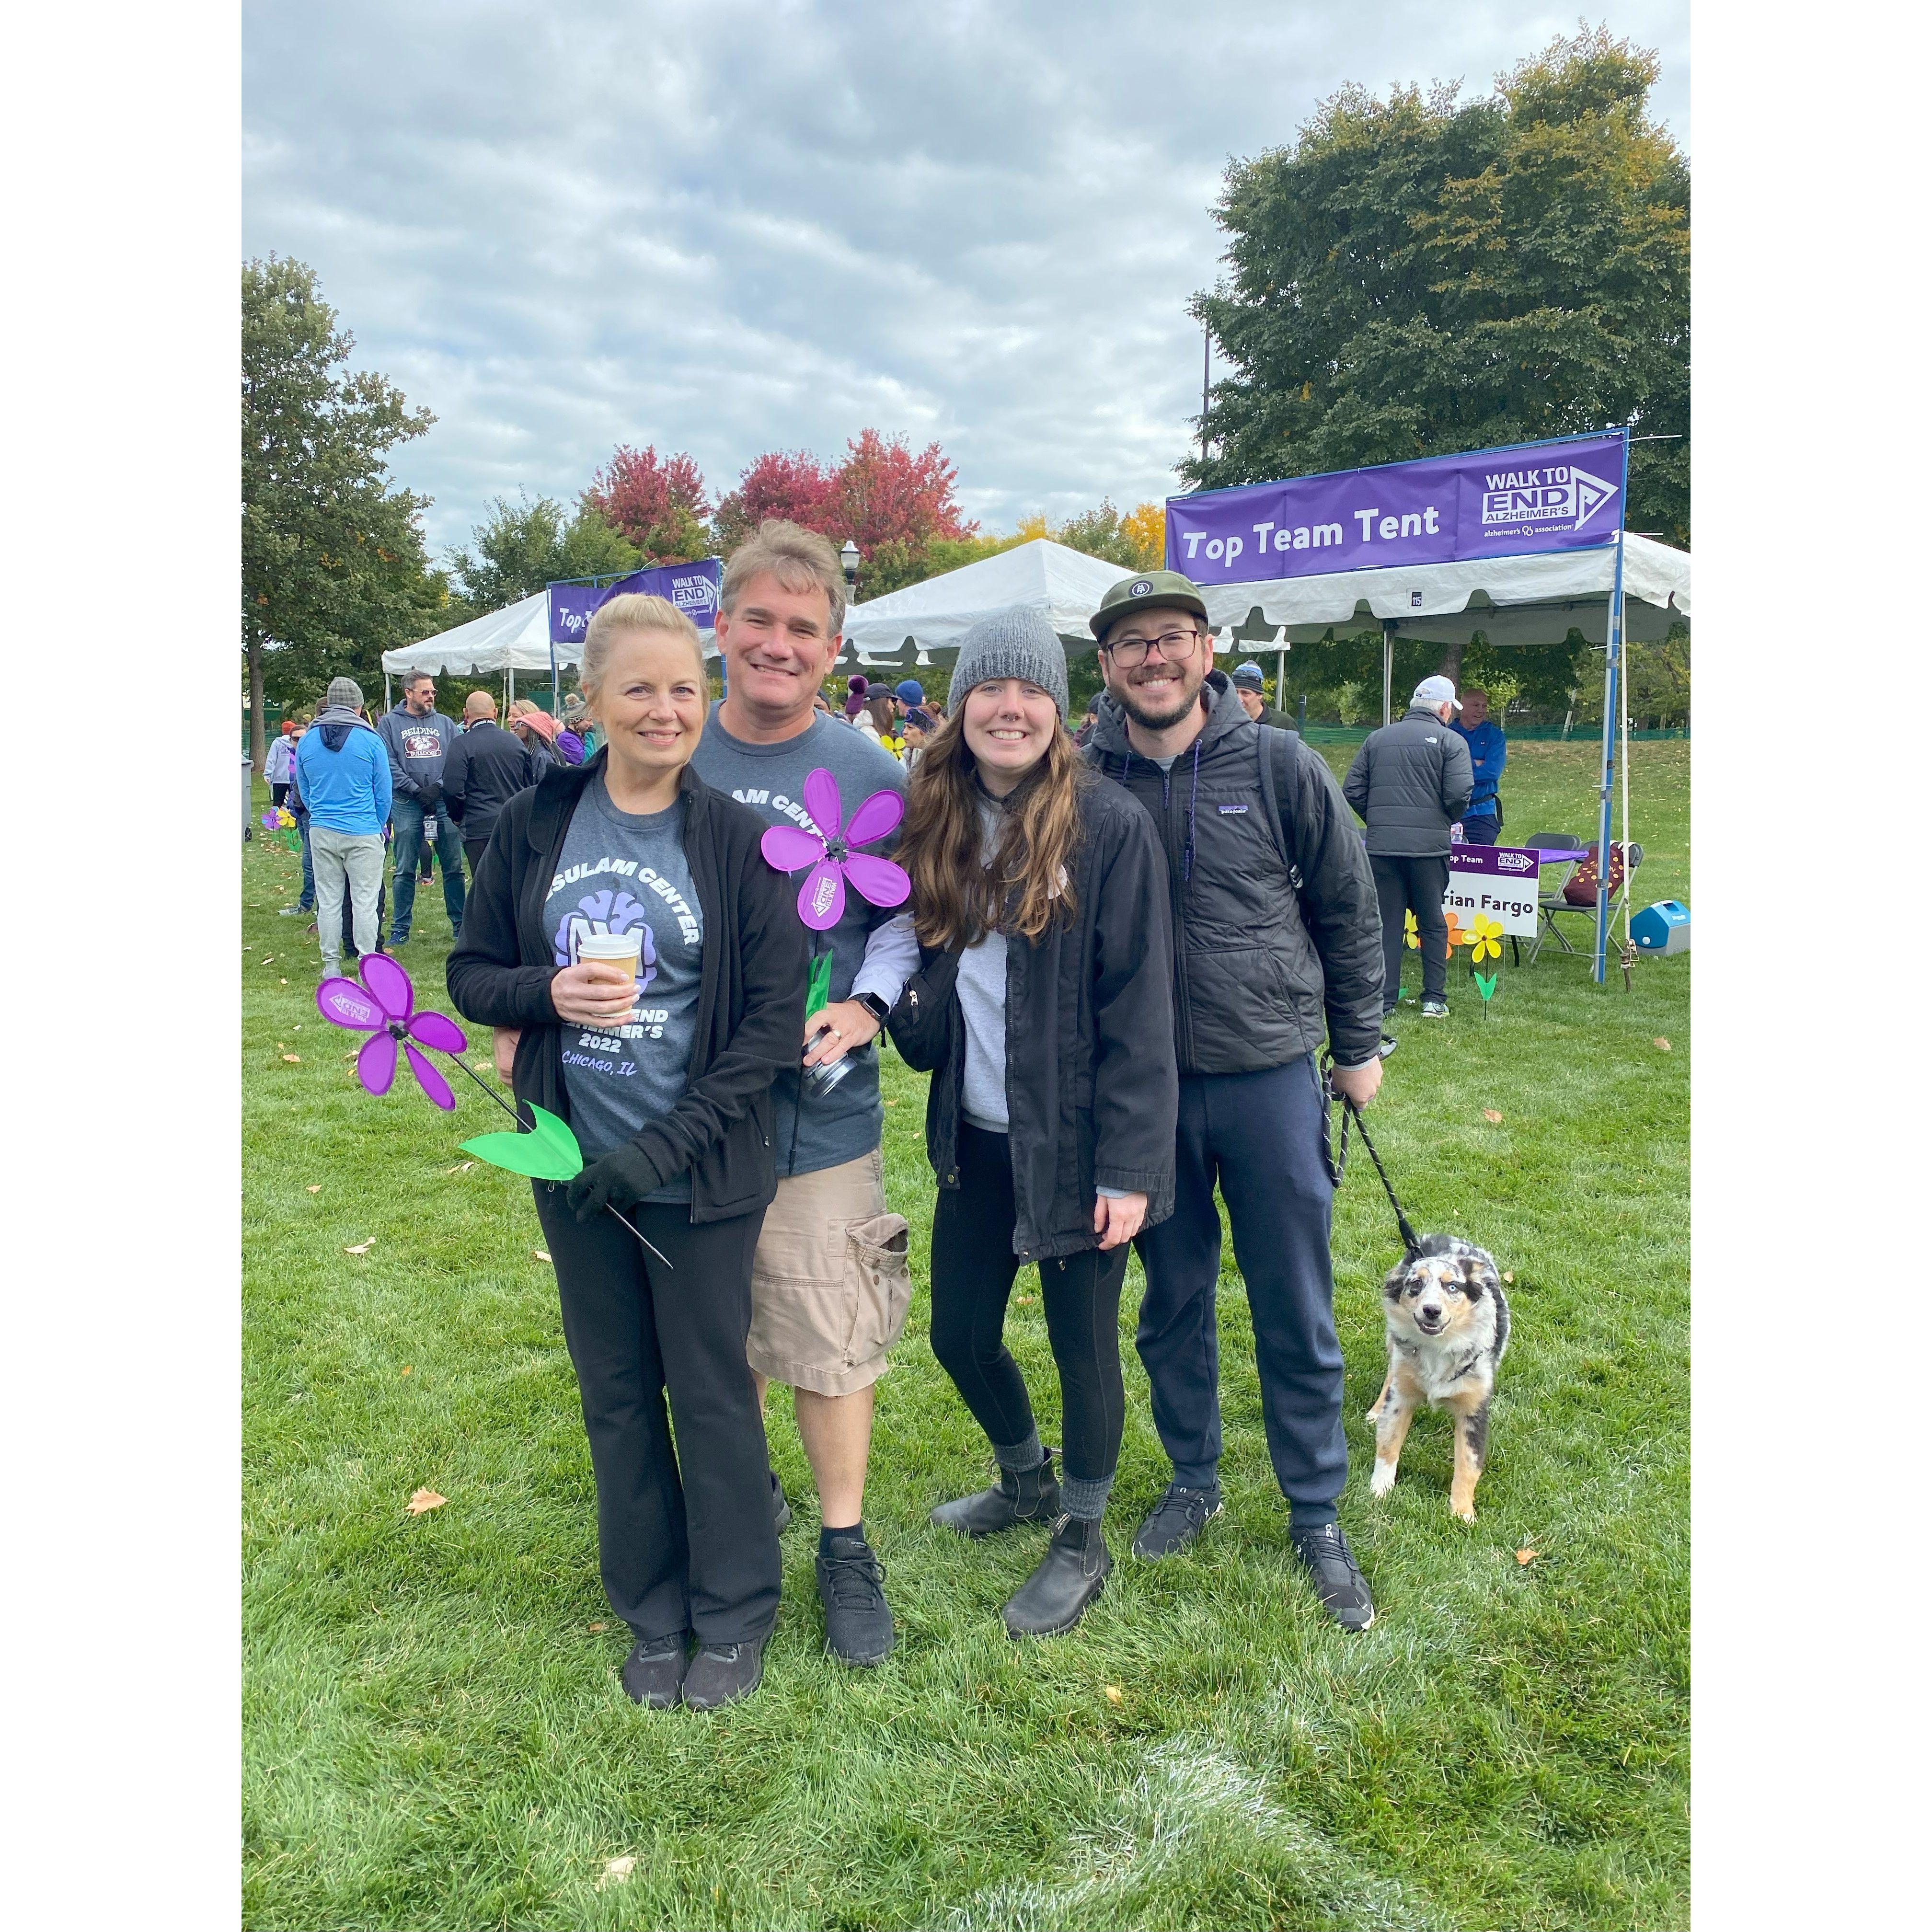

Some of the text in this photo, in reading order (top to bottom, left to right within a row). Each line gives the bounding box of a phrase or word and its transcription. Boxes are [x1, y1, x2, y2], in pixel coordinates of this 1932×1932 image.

[1485, 466, 1568, 491] WALK TO
[1487, 488, 1569, 512] END
[1485, 506, 1568, 522] ALZHEIMER'S
[1183, 506, 1439, 567] Top Team Tent
[1484, 524, 1572, 537] alzheimer's association
[672, 575, 703, 588] WALK TO
[674, 588, 704, 601] END
[1413, 596, 1421, 605] 115
[560, 608, 581, 633] Top
[401, 727, 440, 739] BELDING
[731, 789, 828, 849] AM CENT
[1449, 855, 1483, 863] op Team
[545, 857, 700, 945] SULAM CENTER
[821, 880, 831, 904] END
[828, 882, 837, 899] WALK
[1442, 890, 1533, 917] rian Fargo
[578, 1033, 622, 1053] 2022
[562, 1050, 639, 1076] CHICAGO, IL
